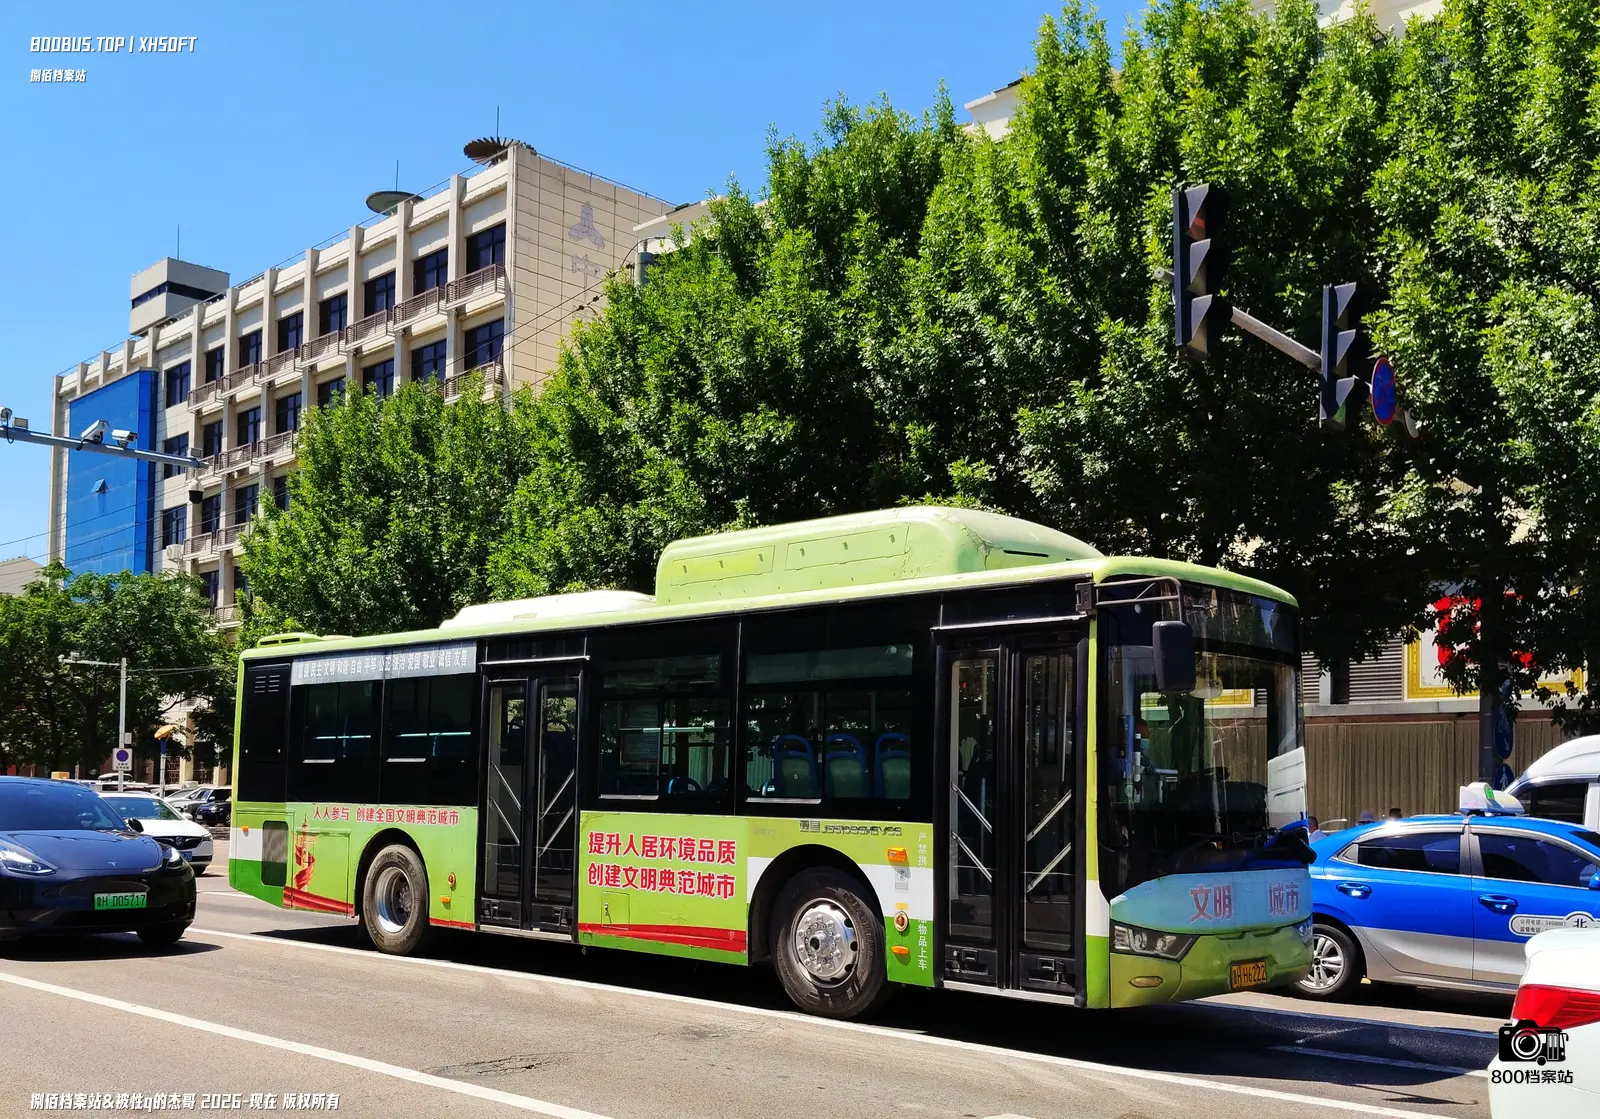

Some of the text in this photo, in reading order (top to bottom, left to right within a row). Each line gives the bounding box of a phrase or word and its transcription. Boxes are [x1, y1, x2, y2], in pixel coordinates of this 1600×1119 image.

[324, 660, 335, 676] 文明
[351, 658, 362, 674] 自由
[364, 656, 377, 673] 平等
[454, 648, 467, 667] 友善
[313, 806, 460, 826] 人人参与 创建全国文明典范城市
[588, 831, 736, 865] 提升人居环境品质
[588, 862, 736, 900] 创建文明典范城市
[1189, 881, 1300, 924] 文明 城市
